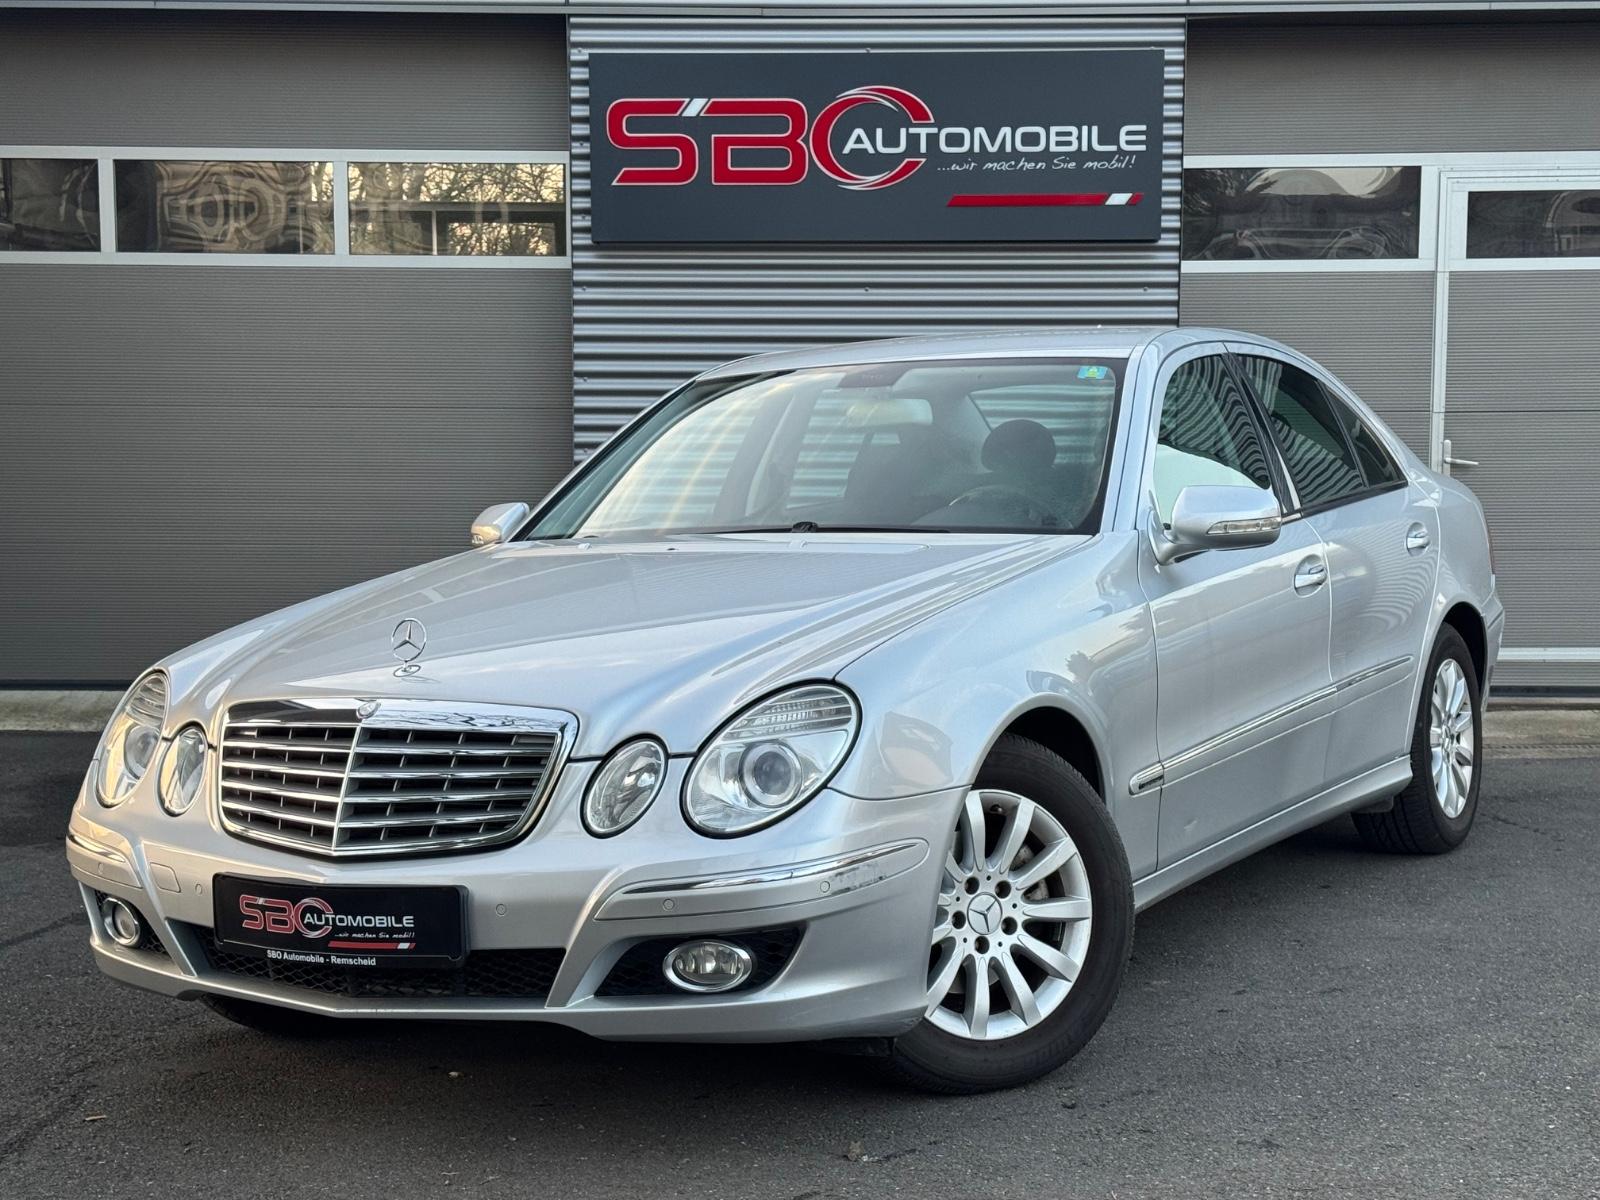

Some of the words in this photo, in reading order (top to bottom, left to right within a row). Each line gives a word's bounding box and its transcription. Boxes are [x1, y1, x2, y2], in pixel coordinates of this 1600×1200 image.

[842, 124, 1148, 155] AUTOMOBILE
[986, 155, 1047, 171] machen
[1053, 155, 1077, 170] Sie
[1083, 156, 1136, 170] mobil!
[303, 913, 415, 928] AUTOMOBILE
[266, 949, 282, 960] SBO
[283, 953, 325, 964] Automobile
[330, 955, 377, 966] Remscheid
